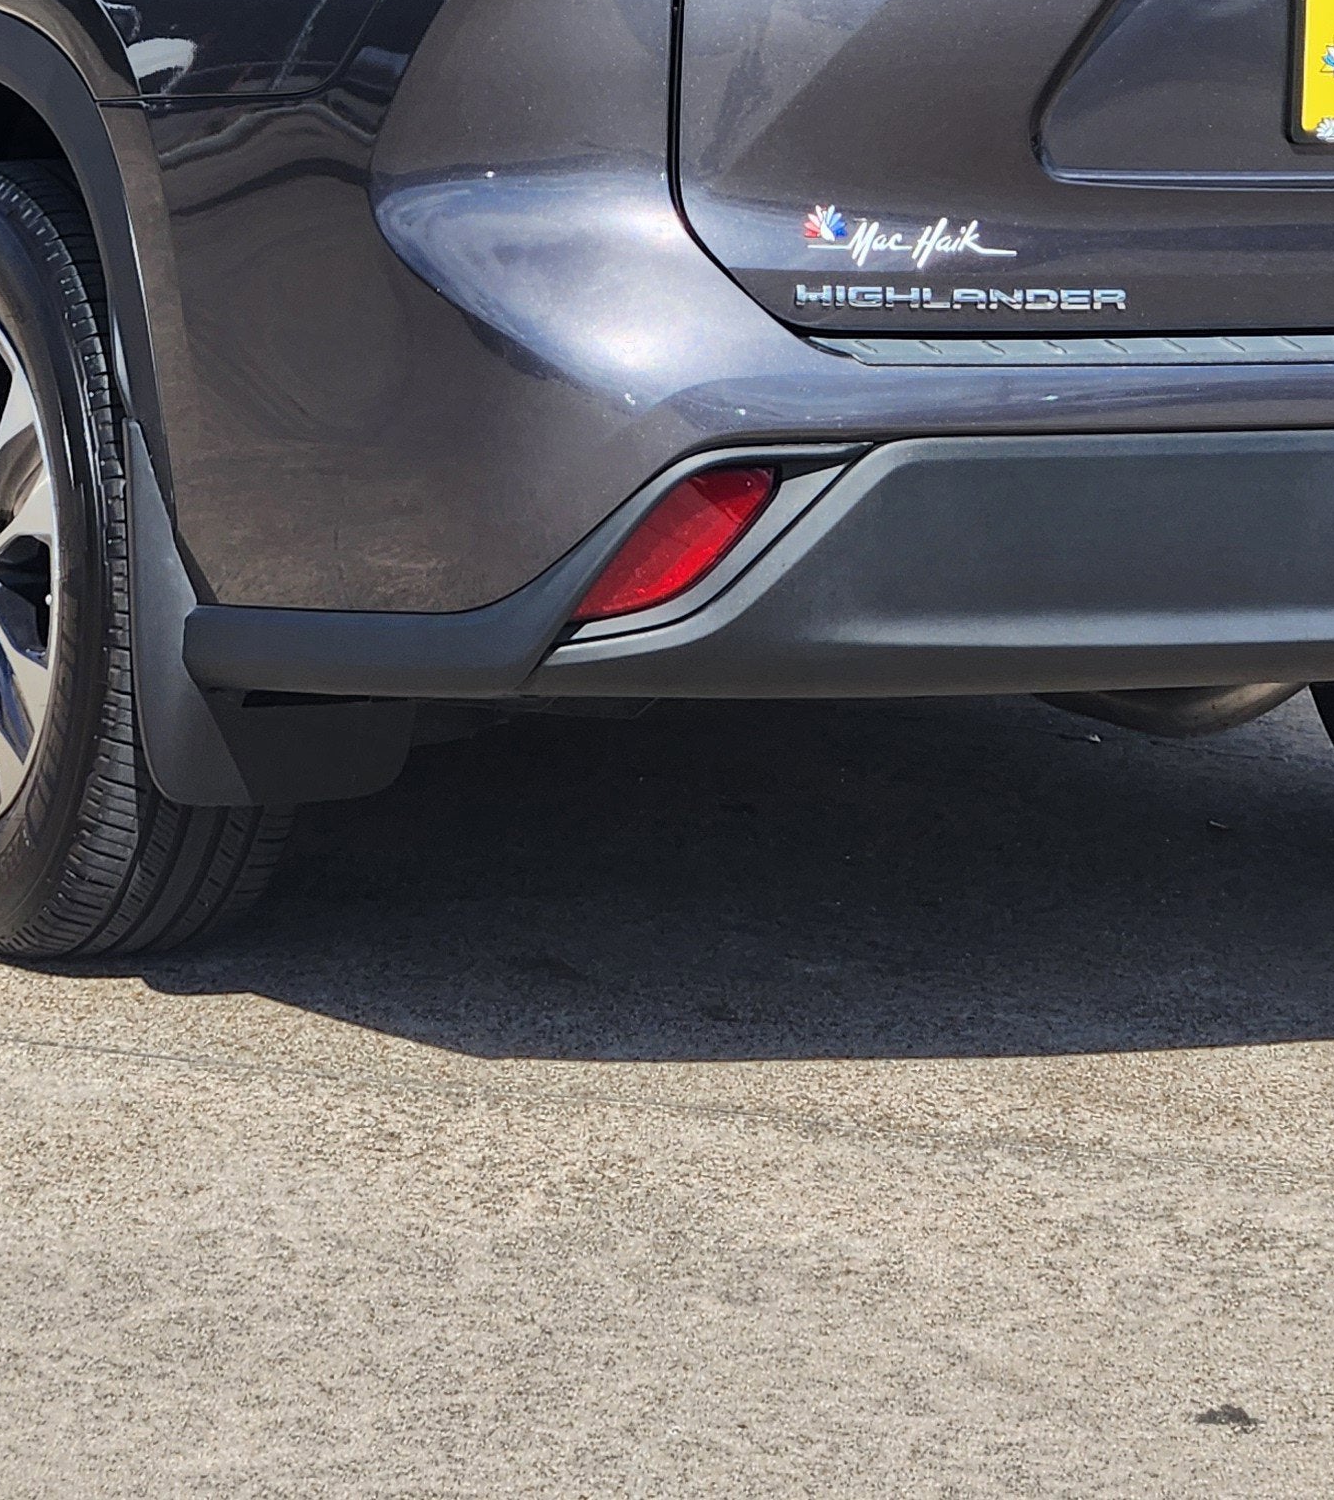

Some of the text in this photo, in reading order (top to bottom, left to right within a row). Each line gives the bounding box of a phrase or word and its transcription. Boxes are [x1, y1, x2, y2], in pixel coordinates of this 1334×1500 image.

[847, 217, 985, 269] Mac Haik
[793, 283, 1127, 311] HIGHLANDER
